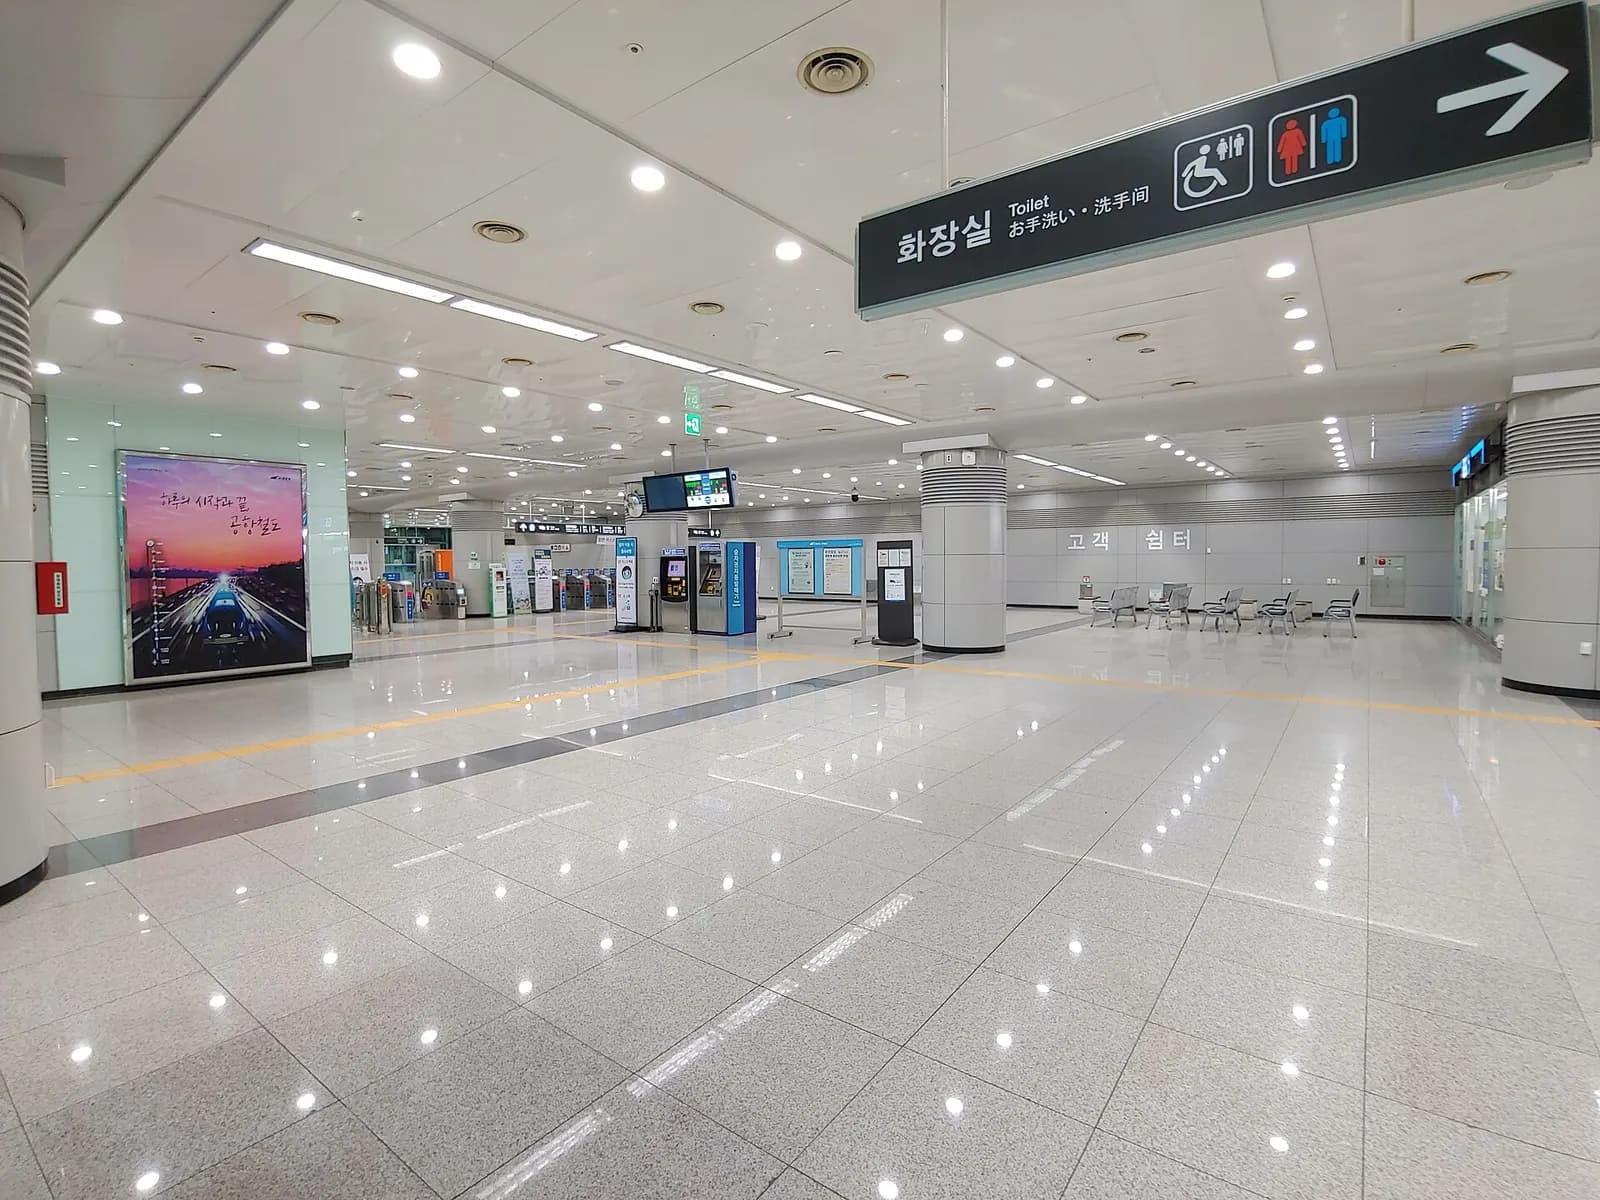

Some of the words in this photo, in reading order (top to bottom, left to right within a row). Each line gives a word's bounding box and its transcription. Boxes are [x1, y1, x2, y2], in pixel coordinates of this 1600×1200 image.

[1008, 195, 1050, 217] Toilet
[897, 210, 992, 264] 화장실
[160, 492, 190, 510] 하루의
[195, 495, 234, 511] 시작과
[236, 496, 250, 513] 끝
[230, 515, 281, 536] 공항철도
[1067, 531, 1109, 551] 고객
[1145, 528, 1191, 551] 쉼터
